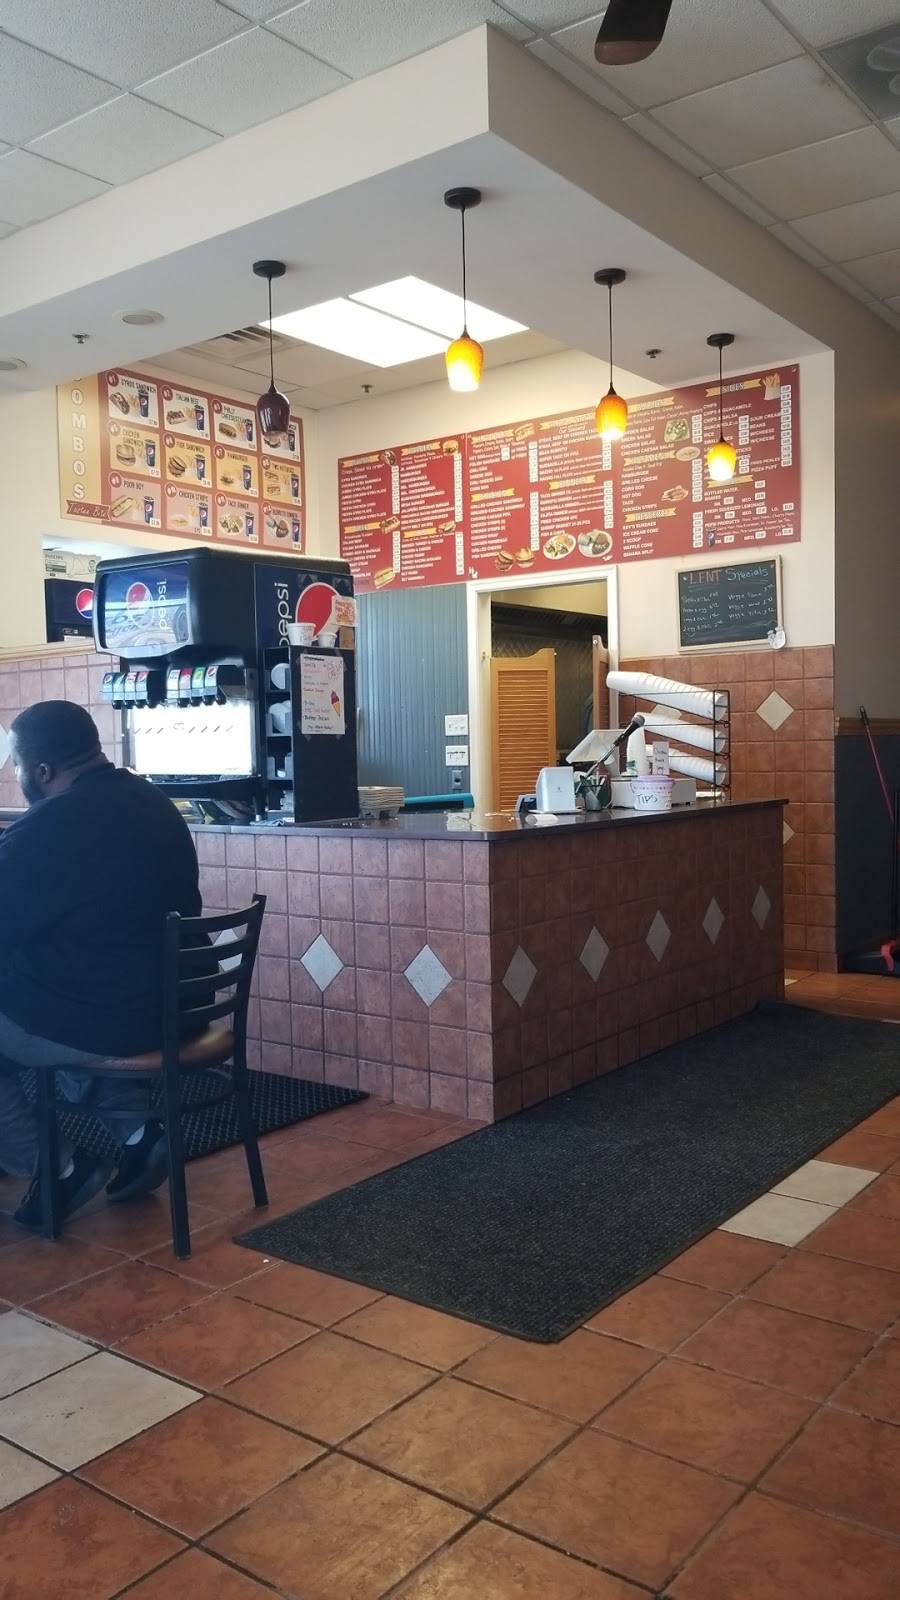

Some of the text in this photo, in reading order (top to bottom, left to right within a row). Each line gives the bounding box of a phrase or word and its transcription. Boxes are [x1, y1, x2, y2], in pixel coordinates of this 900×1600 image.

[136, 382, 156, 393] SANDWICH
[721, 383, 744, 394] SIDES
[71, 378, 86, 499] OMBOS
[123, 480, 144, 490] POOR BOY
[725, 566, 769, 581] Specials
[157, 578, 167, 630] pepsi
